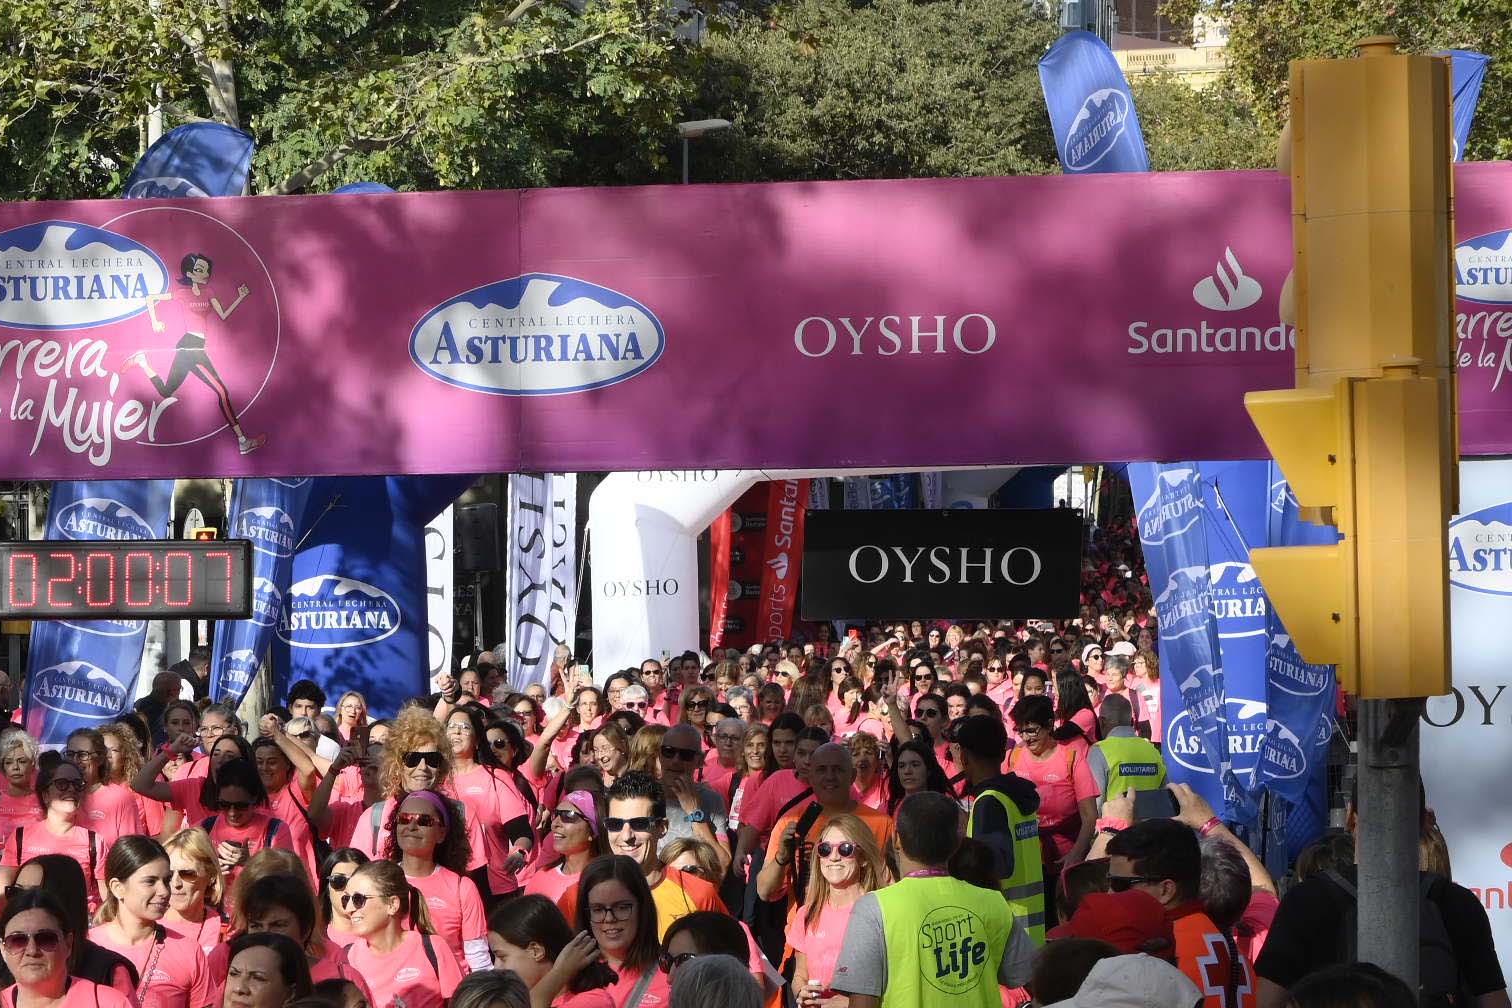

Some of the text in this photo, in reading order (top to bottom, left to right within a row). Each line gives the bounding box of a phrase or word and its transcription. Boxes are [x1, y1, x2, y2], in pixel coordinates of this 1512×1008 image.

[71, 256, 143, 268] LECHERA
[1469, 256, 1512, 264] CENTRA
[469, 315, 636, 329] CENTRAL LECHERA
[794, 313, 997, 358] OYSHO
[1127, 321, 1296, 354] Santand
[429, 321, 645, 365] ASTURIANA
[9, 383, 34, 421] la
[30, 372, 178, 466] Mujer
[9, 553, 232, 607] 02:00:07
[849, 545, 1042, 585] OYSHO
[603, 578, 679, 599] OYSHO
[279, 609, 391, 632] ASTURIANA
[36, 679, 122, 712] ASTURIANA
[1419, 685, 1507, 727] OY
[922, 914, 976, 949] Sport
[934, 937, 986, 980] Life
